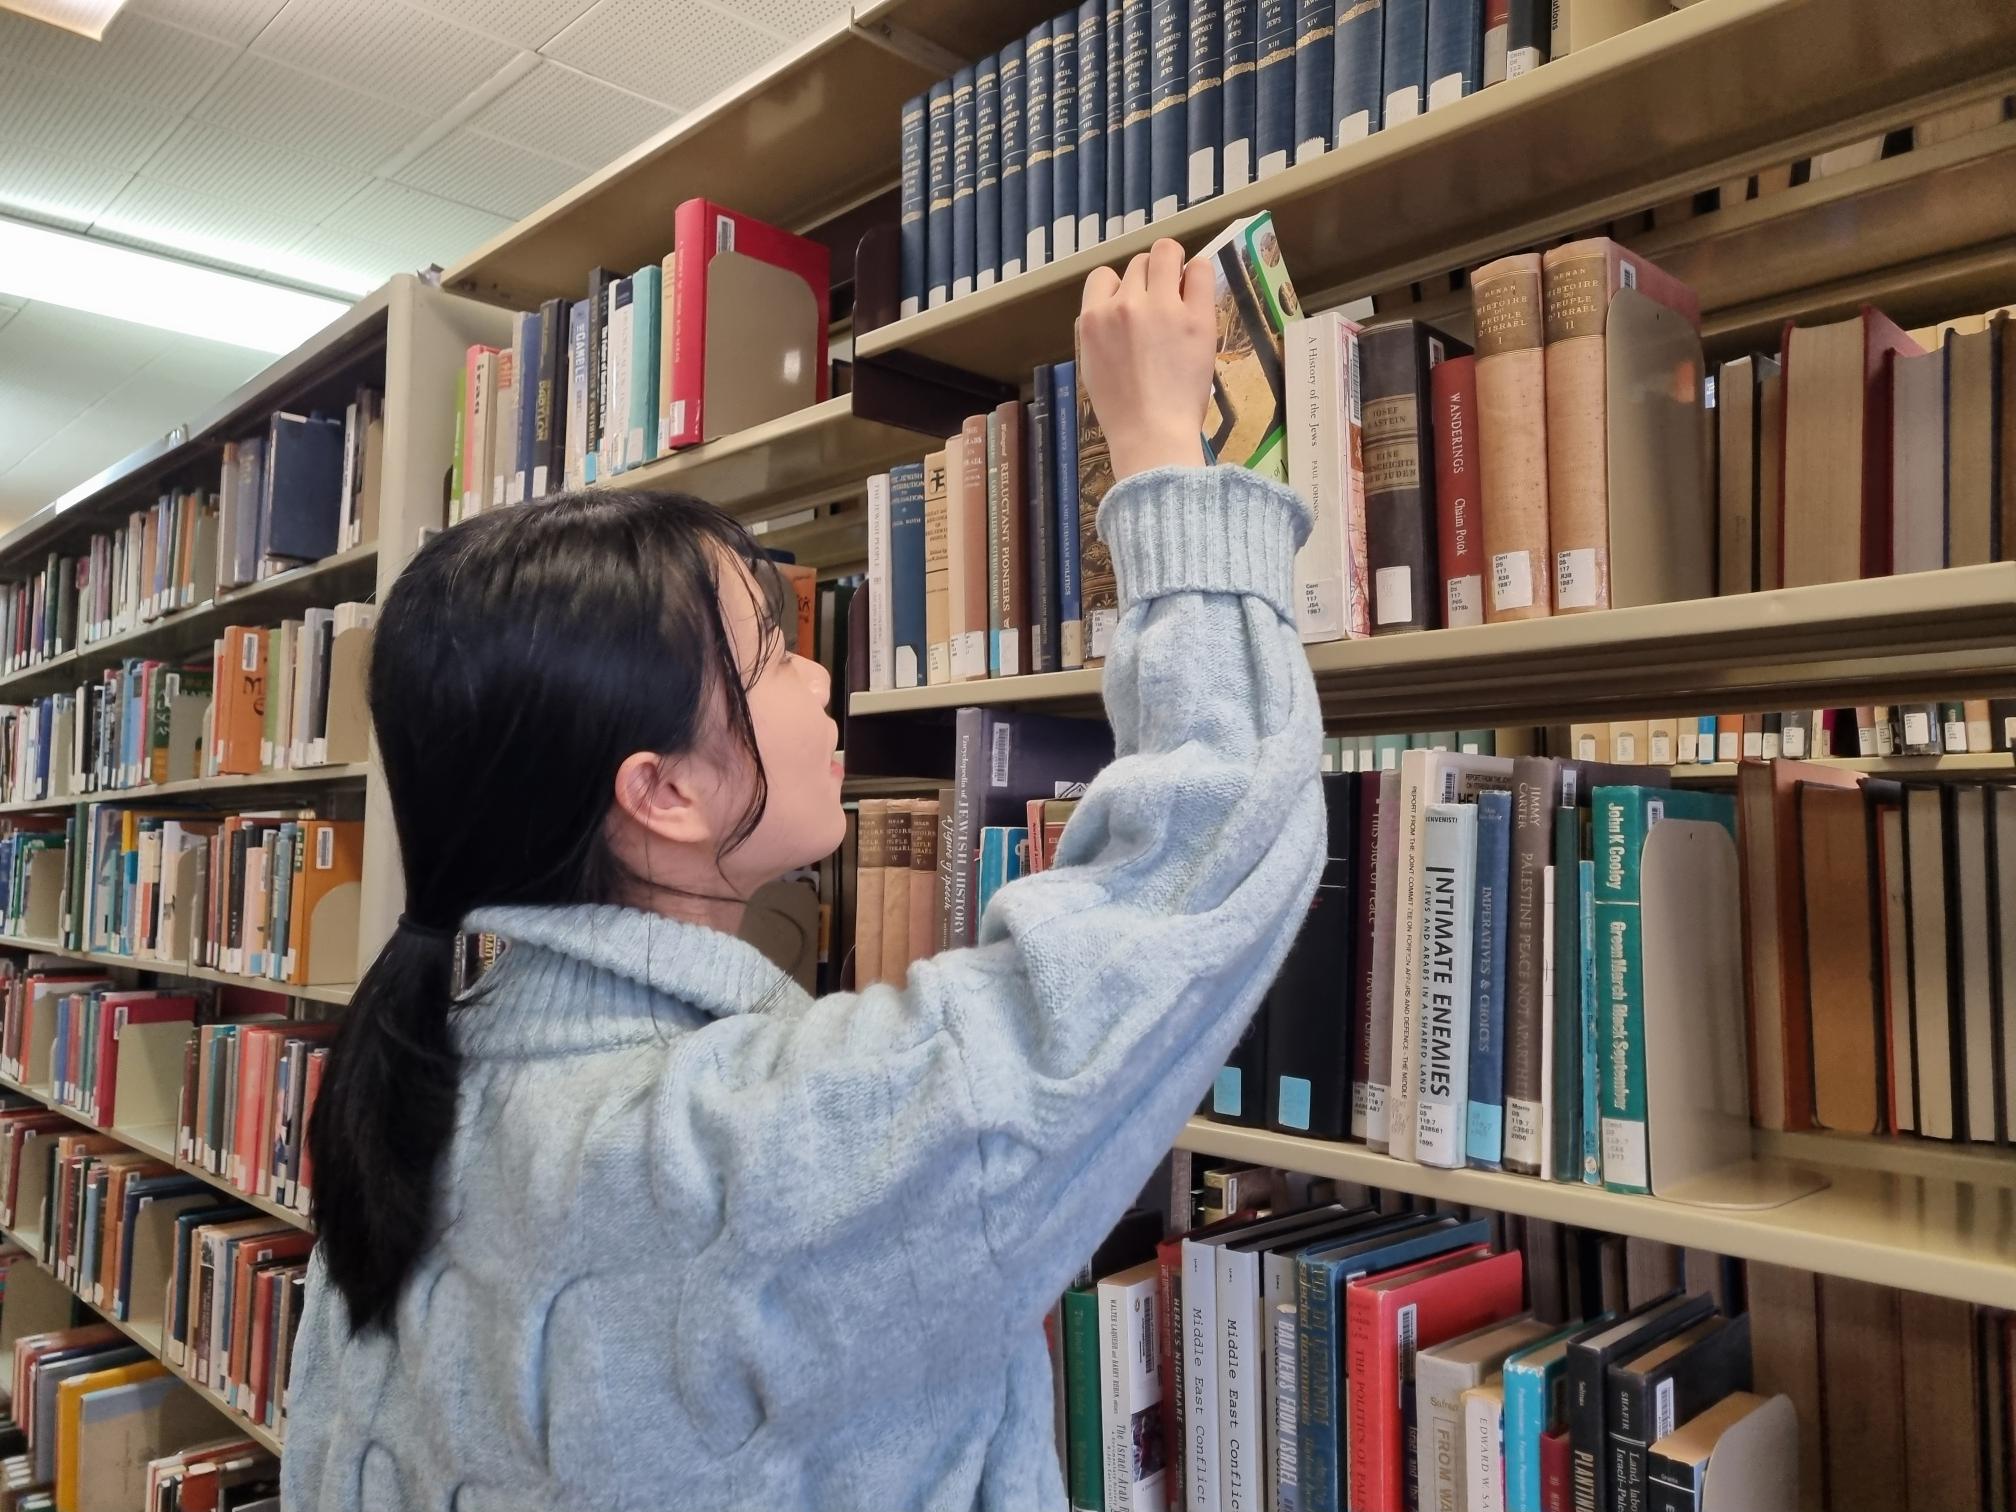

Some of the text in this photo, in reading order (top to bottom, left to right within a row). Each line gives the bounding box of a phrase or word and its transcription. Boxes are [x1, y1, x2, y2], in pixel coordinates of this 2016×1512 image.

[1266, 17, 1281, 29] JEWS
[574, 330, 586, 383] GAMBLE
[1308, 336, 1318, 344] A
[1307, 347, 1318, 385] History
[1310, 402, 1319, 419] the
[1311, 389, 1320, 400] of
[1309, 422, 1320, 447] Jews
[1450, 392, 1468, 556] WANDERINGS Chaim Potok
[1001, 462, 1010, 612] RELUCTANT PIONEERS
[1518, 782, 1529, 829] CARTER
[1529, 786, 1541, 827] JIMMY
[958, 801, 969, 865] JEWISH
[1606, 803, 1626, 890] John K Cooley
[954, 872, 967, 936] HISTORY
[1424, 885, 1432, 912] JEWS
[1519, 853, 1533, 930] PALESTINE
[1406, 920, 1412, 933] ON
[1423, 918, 1431, 941] AND
[1422, 946, 1430, 981] ARABS
[1479, 887, 1492, 1053] IMPERATIVES & CHOICES
[1519, 934, 1531, 978] PEACE
[1421, 987, 1429, 997] IN
[1426, 866, 1455, 1097] INTIMATE ENEMIES
[1517, 983, 1530, 1016] NOT
[1402, 1015, 1410, 1049] DEFENCE
[1420, 1015, 1428, 1058] SHARED
[1611, 921, 1630, 1111] Green March Black September
[1400, 1071, 1408, 1099] MIDDLE
[1419, 1064, 1427, 1094] LAND
[1228, 1319, 1239, 1379] Middle
[1279, 1320, 1295, 1350] BAD
[1175, 1351, 1183, 1423] NIGHTMARE
[1279, 1352, 1296, 1392] NEWS
[1193, 1308, 1207, 1504] Middle East Conflict
[1230, 1388, 1239, 1429] East
[1279, 1395, 1297, 1436] FROM
[1356, 1351, 1366, 1465] THE POLITICS OF
[1621, 1391, 1630, 1430] SHAFIR
[1117, 1425, 1126, 1440] The
[1480, 1418, 1489, 1473] EDWARD
[1280, 1438, 1297, 1487] ISRAEL
[1438, 1428, 1451, 1481] FROM
[1629, 1452, 1641, 1485] Land,
